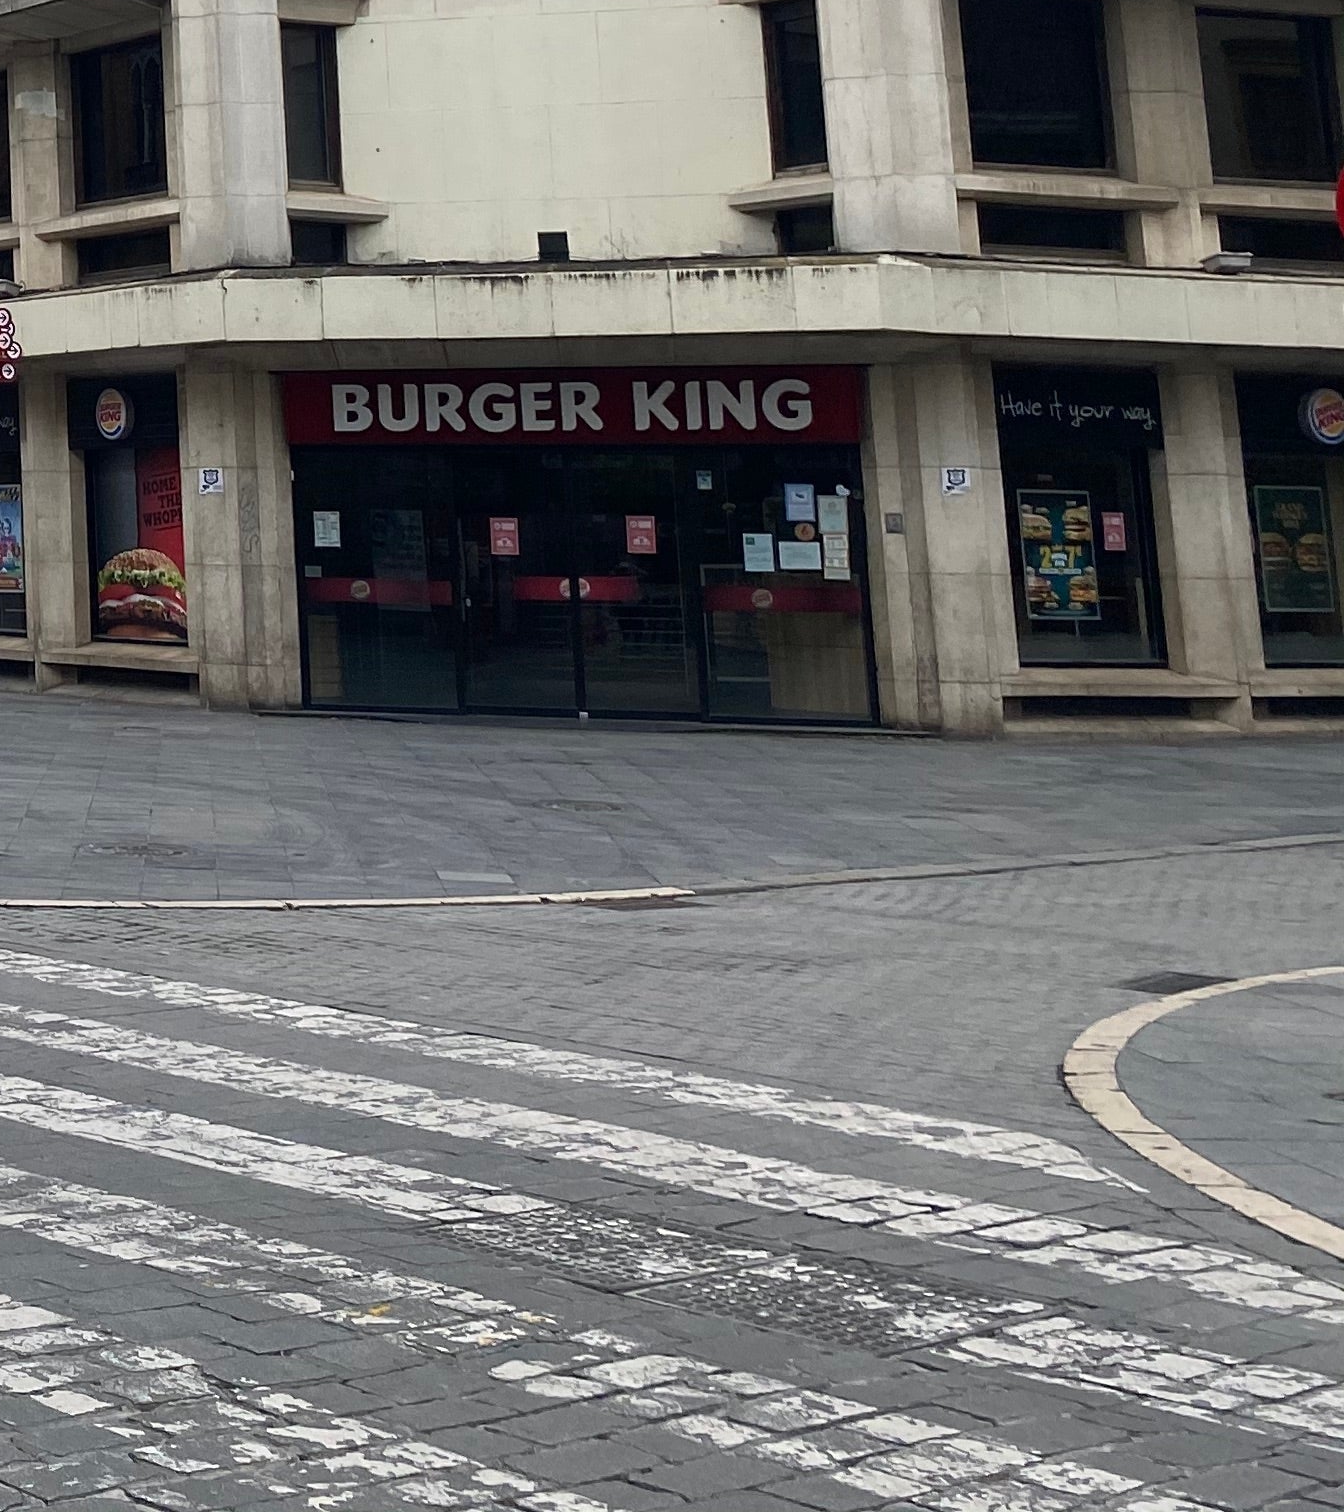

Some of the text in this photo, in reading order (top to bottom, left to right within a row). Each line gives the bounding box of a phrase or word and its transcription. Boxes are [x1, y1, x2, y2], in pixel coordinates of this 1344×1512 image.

[100, 410, 122, 423] KING
[332, 379, 813, 433] BURGER KING
[1000, 390, 1043, 417] Have
[1049, 390, 1062, 422] it
[1069, 403, 1115, 428] your
[143, 476, 177, 496] HOME
